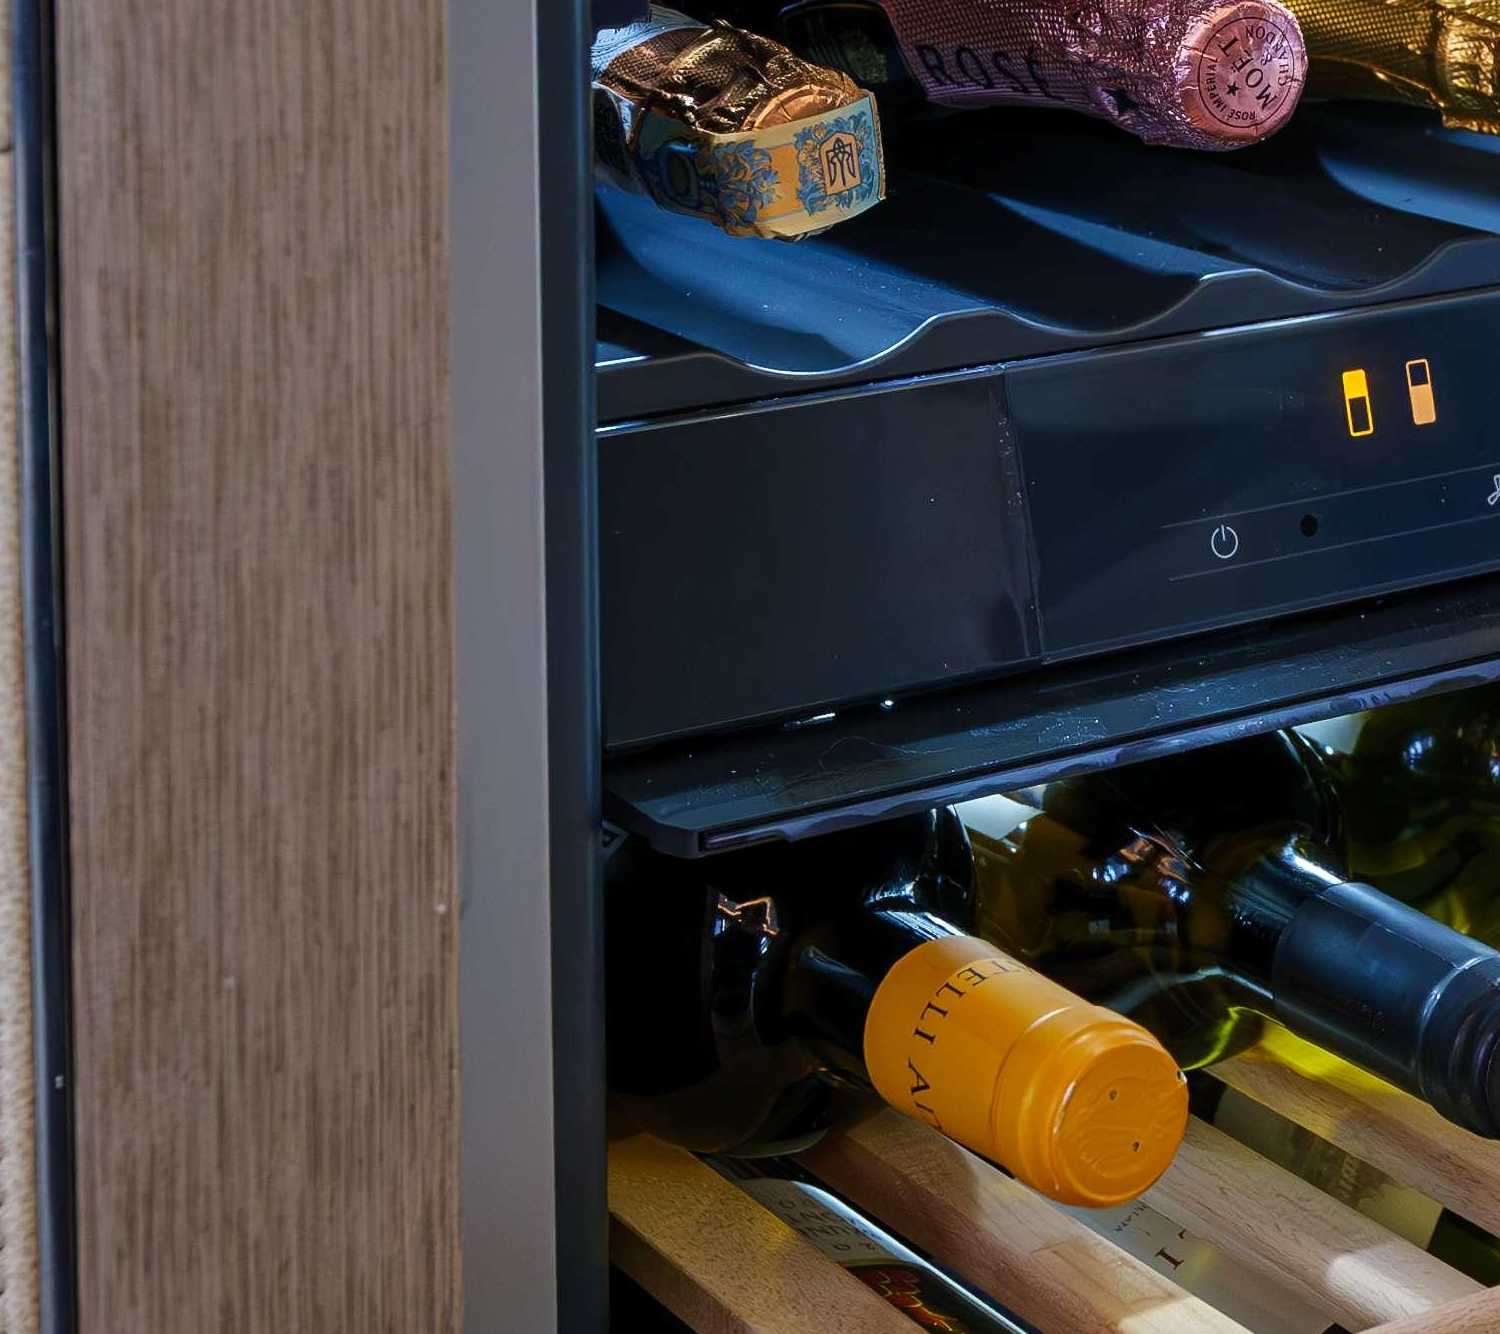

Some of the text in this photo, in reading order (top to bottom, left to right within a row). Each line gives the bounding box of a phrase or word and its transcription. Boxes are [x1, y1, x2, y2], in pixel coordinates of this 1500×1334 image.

[1218, 36, 1279, 109] MOËT
[1245, 24, 1289, 87] CHANDON
[1261, 49, 1273, 67] &
[914, 960, 1032, 1045] TELLI
